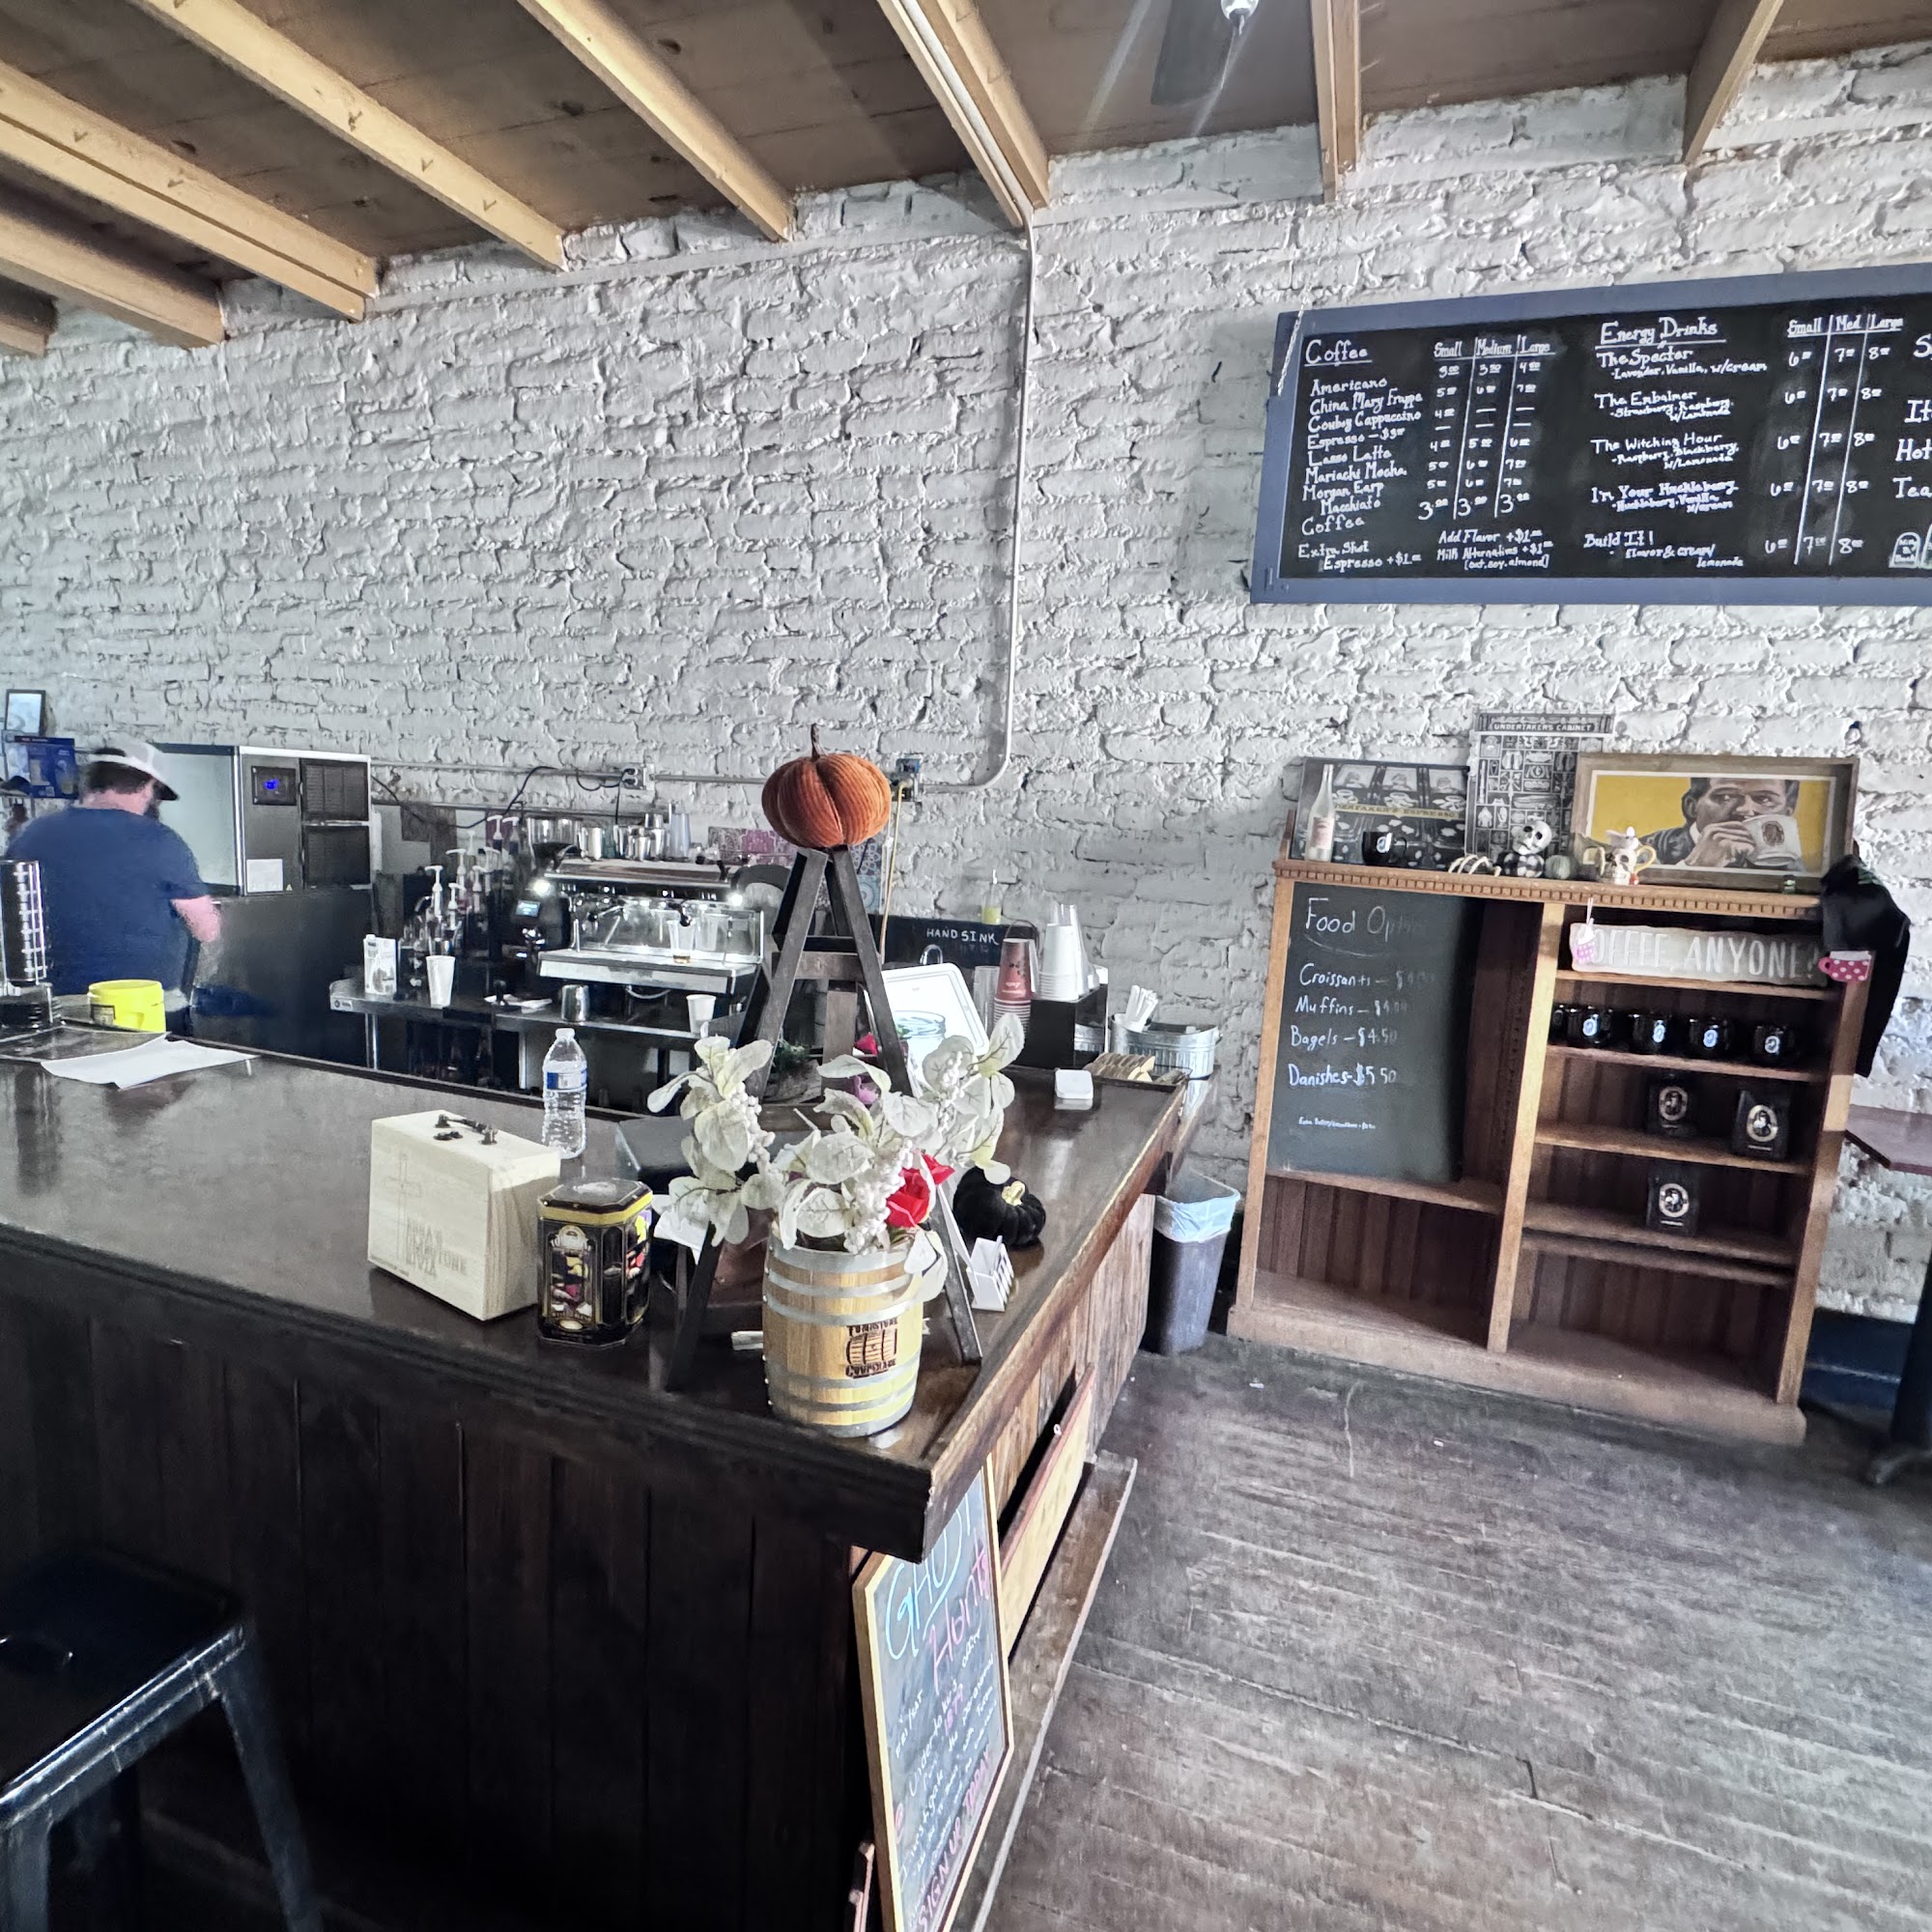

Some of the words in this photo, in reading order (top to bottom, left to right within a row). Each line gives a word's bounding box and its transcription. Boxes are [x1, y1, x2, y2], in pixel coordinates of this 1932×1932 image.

[1600, 321, 1656, 345] Energy
[1659, 316, 1718, 339] Drinks
[1835, 314, 1861, 331] Med
[1305, 339, 1368, 365] Coffee
[1434, 340, 1463, 357] Small
[1596, 352, 1629, 368] The
[1310, 378, 1388, 397] Americano
[1310, 398, 1350, 415] China
[1352, 391, 1384, 413] Mary
[1594, 392, 1627, 409] The
[1590, 439, 1620, 454] The
[1625, 436, 1681, 451] Witching
[1683, 432, 1723, 446] Hour
[1305, 465, 1361, 484] Mariachi
[1364, 460, 1407, 479] Mocha
[1302, 484, 1350, 501] Morgan
[1353, 479, 1384, 497] Earp
[1618, 485, 1655, 499] Your
[1320, 495, 1381, 516] Macchiato
[1301, 514, 1365, 535] Coffee
[1438, 528, 1462, 544] Add
[1463, 528, 1500, 543] Flavor
[1583, 531, 1621, 548] Build
[1297, 543, 1341, 558] Extra
[1342, 540, 1370, 554] Shot
[1323, 554, 1383, 573] Espresso
[1305, 897, 1356, 933] Food
[926, 928, 958, 939] HAND
[961, 930, 1000, 945] SINK
[1299, 963, 1371, 988] Croissants
[1295, 995, 1353, 1015] Muffins
[1291, 1025, 1338, 1051] Bagels
